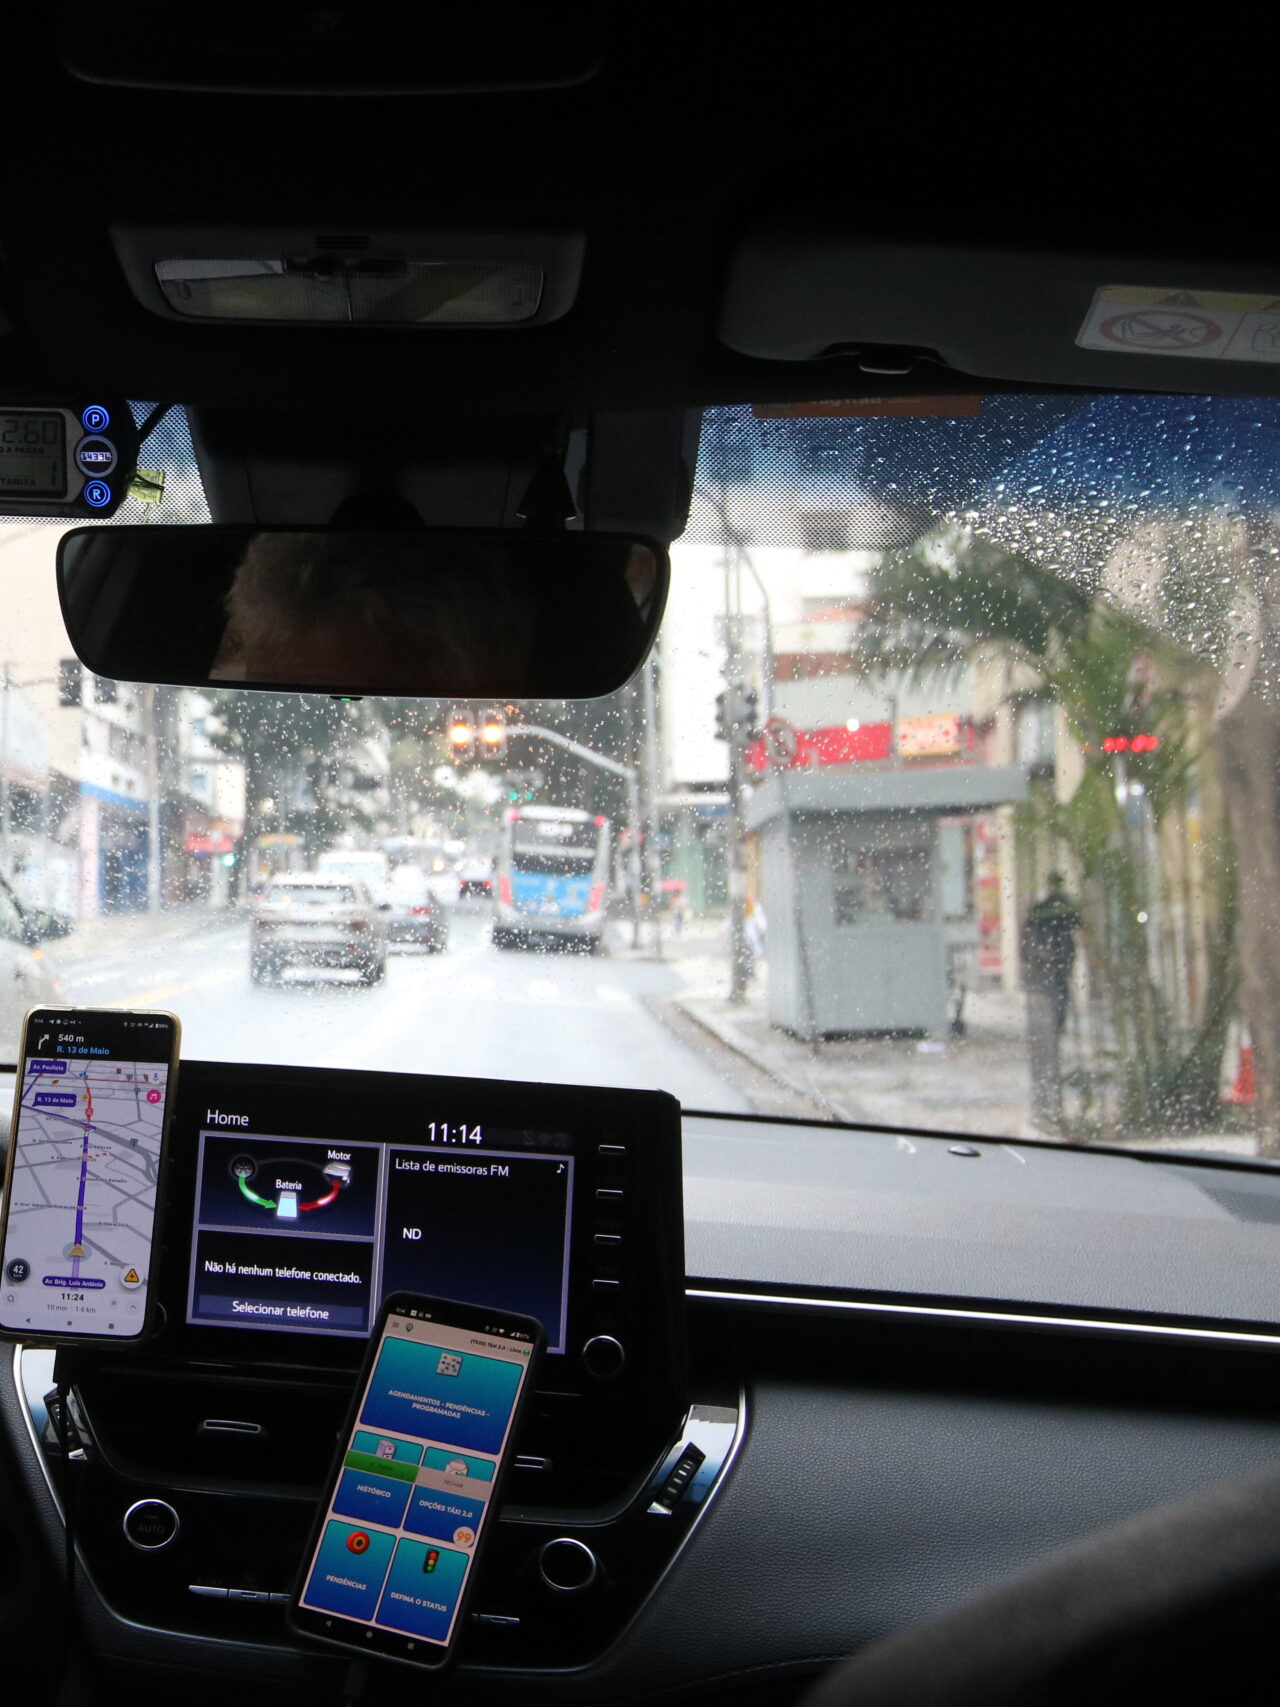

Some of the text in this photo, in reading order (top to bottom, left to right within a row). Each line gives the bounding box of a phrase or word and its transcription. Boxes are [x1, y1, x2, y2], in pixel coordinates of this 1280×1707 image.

[92, 414, 100, 425] P
[0, 478, 36, 486] TARIFA
[92, 489, 101, 499] R
[58, 1034, 74, 1042] 540
[68, 1046, 77, 1054] 13
[78, 1046, 88, 1054] de
[90, 1047, 110, 1055] Maio
[206, 1108, 249, 1126] Home
[427, 1122, 482, 1144] 11:14
[328, 1149, 352, 1161] Motor
[395, 1158, 509, 1177] Lista de emissoras FM
[275, 1179, 302, 1191] Bateria
[402, 1227, 422, 1240] ND
[13, 1265, 23, 1274] 42
[205, 1260, 362, 1284] Não há nenhum telefone conectado.
[54, 1278, 67, 1287] Brig.
[61, 1293, 84, 1301] 11:24
[86, 1306, 96, 1314] km
[232, 1300, 329, 1319] Selecionar telefone
[388, 1389, 440, 1406] AGENDAMENTOS
[446, 1401, 486, 1416] PENDÊNCIAS
[412, 1403, 461, 1419] PROGRAMADAS
[357, 1484, 391, 1498] HISTÓRICO
[419, 1499, 473, 1518] OPÇÕES TÁXI 2.0
[457, 1531, 472, 1543] 99
[326, 1574, 367, 1590] PENDÊNCIAS
[390, 1591, 414, 1604] DEFINA
[422, 1599, 448, 1613] STATUS
